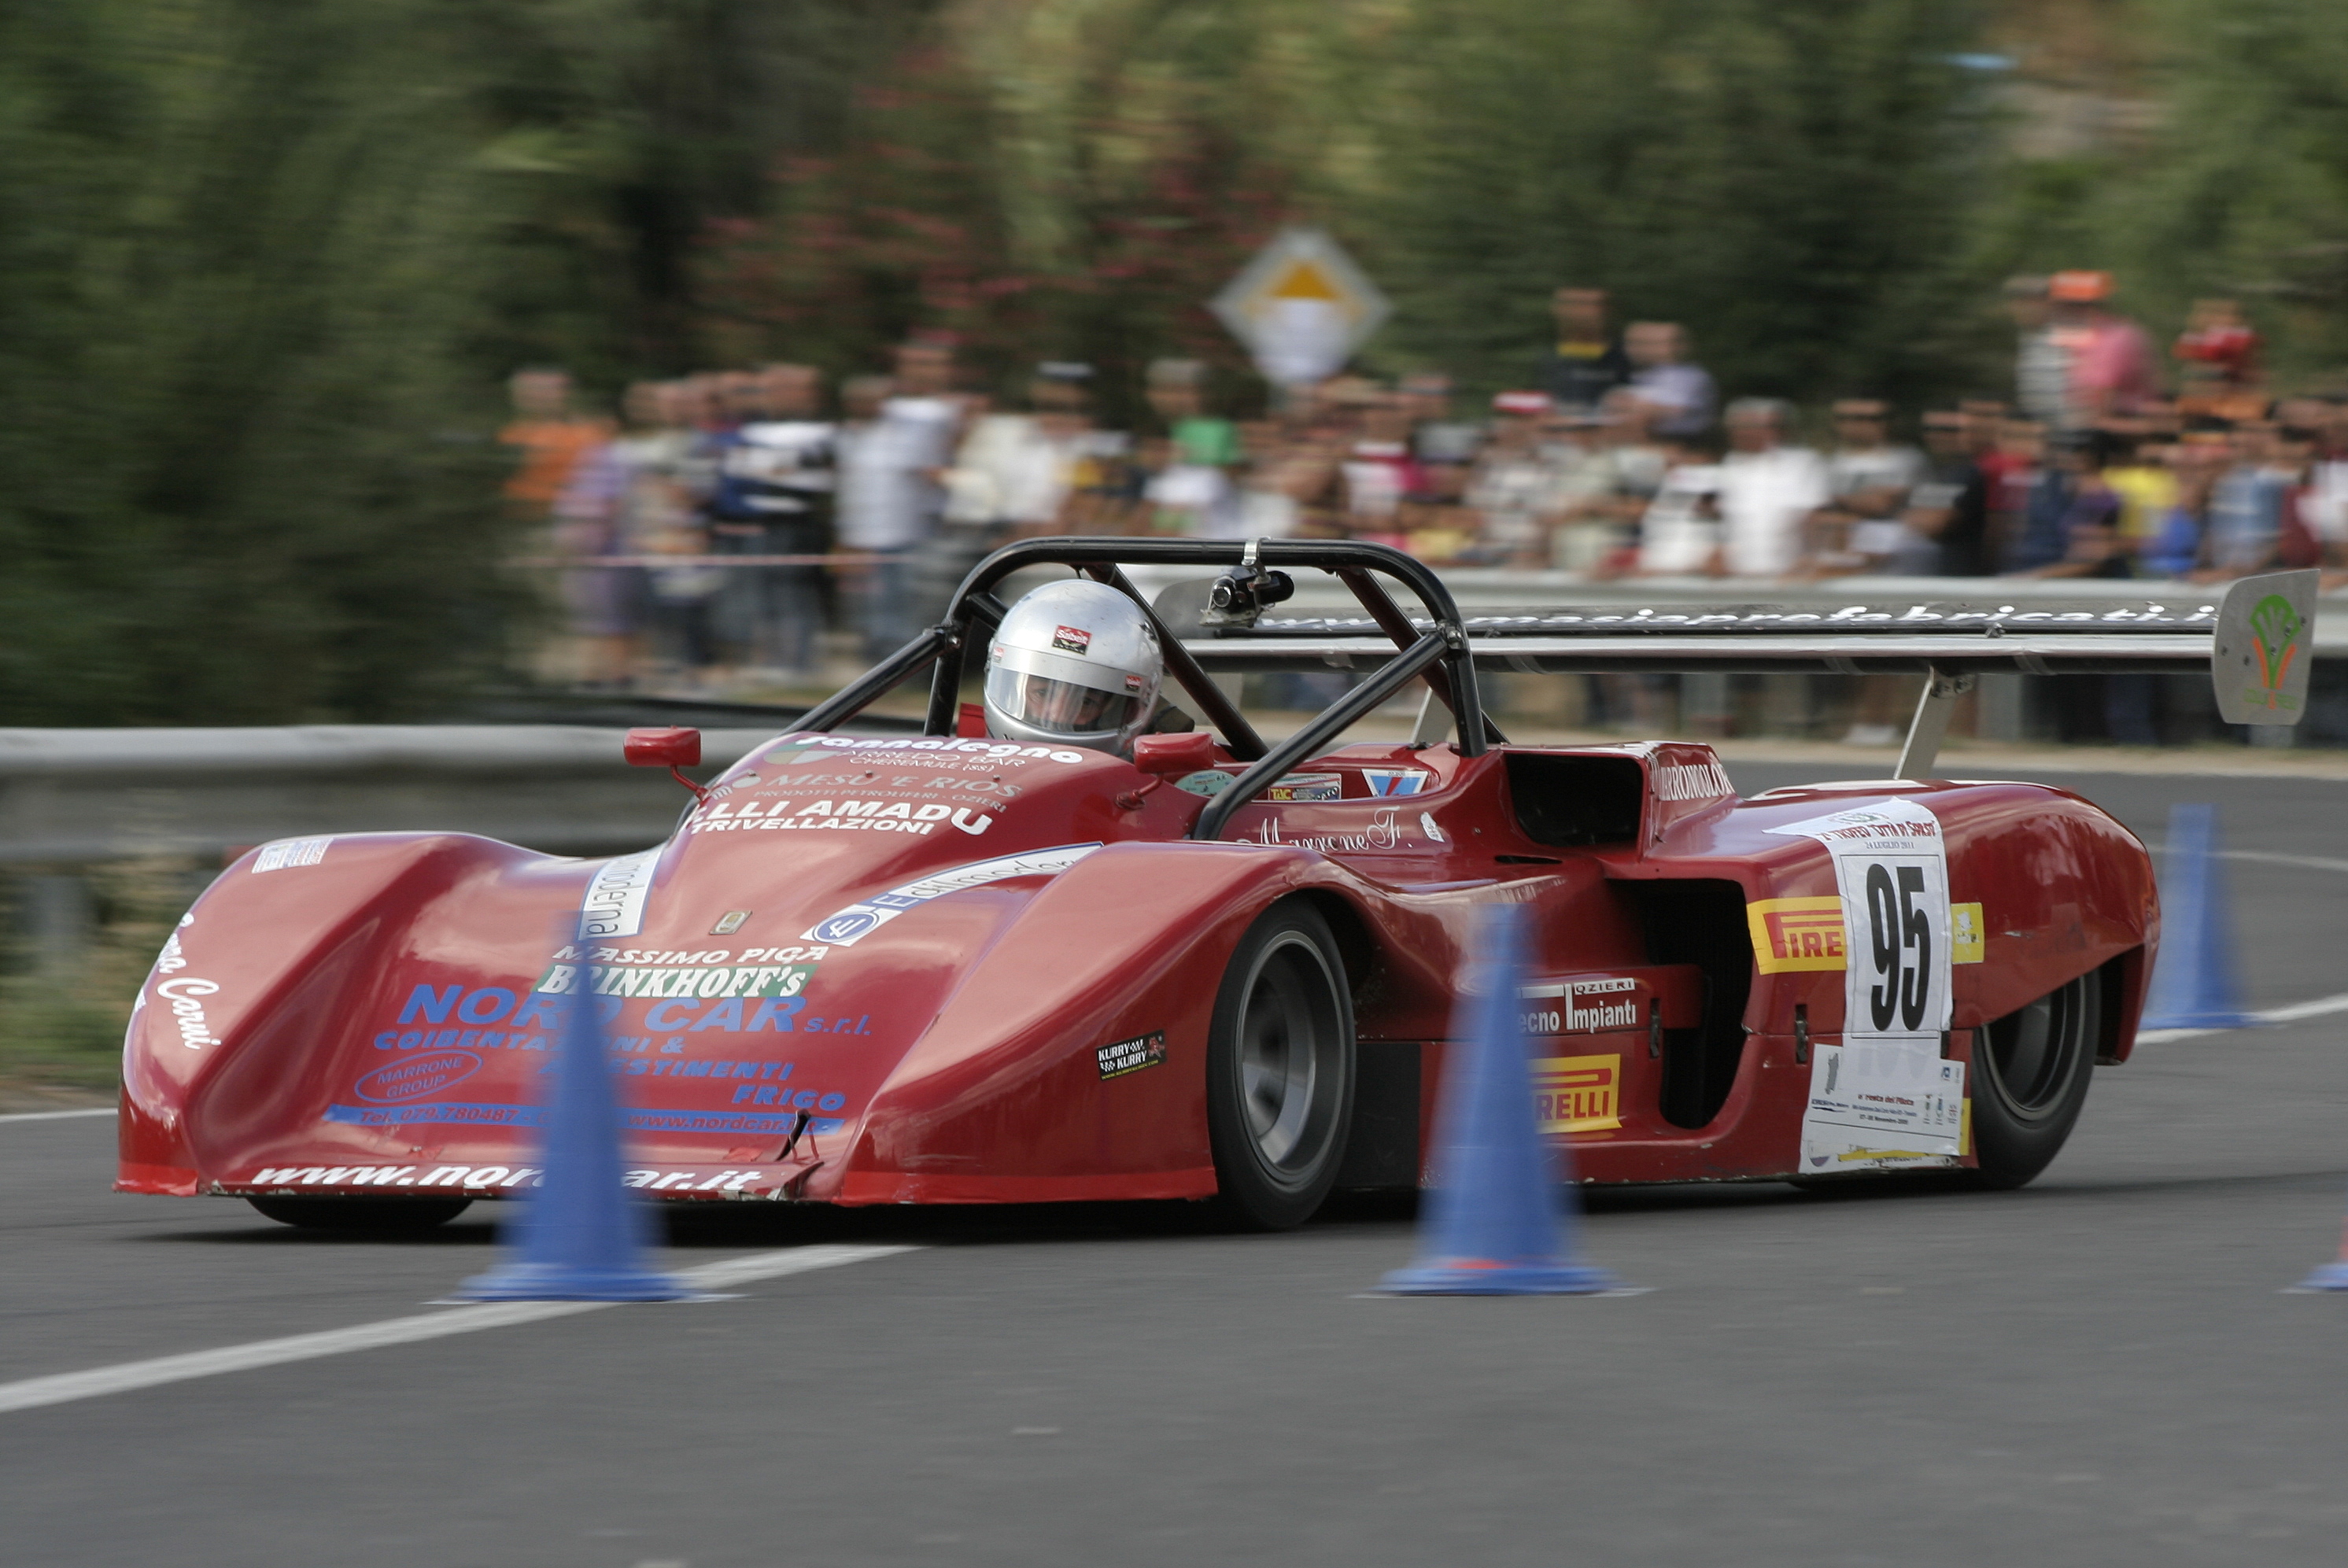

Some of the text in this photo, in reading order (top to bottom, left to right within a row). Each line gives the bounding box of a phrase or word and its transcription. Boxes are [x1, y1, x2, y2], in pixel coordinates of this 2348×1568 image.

[837, 750, 1025, 767] ARREDO BAR
[753, 789, 836, 799] PRODOTTI
[767, 774, 878, 787] MESU
[934, 777, 1022, 798] RIOS
[691, 817, 936, 836] TRIVELLAZIONI
[798, 799, 994, 836] AMADU
[1763, 909, 1845, 959] PIRE
[552, 945, 829, 965] MASSIMO PIGA
[1866, 863, 1931, 1032] 95
[1575, 980, 1634, 994] OZIERI
[396, 983, 871, 1035] NORD CAR s.r.l.
[1517, 983, 1637, 1034] ecno Impianti
[373, 1029, 685, 1053] COIBENTANI &
[1098, 1042, 1130, 1061] KURRY
[378, 1057, 463, 1084] MARRONE
[538, 1057, 795, 1080] AESTIMENTI
[1117, 1050, 1147, 1069] KURRY
[386, 1075, 447, 1099] GROUP
[731, 1085, 846, 1111] FRIGO
[360, 1111, 393, 1123] Tel.
[399, 1106, 519, 1122] 079.780487
[629, 1113, 817, 1133] www.nordcar.it
[251, 1164, 763, 1191] www.norar.it
